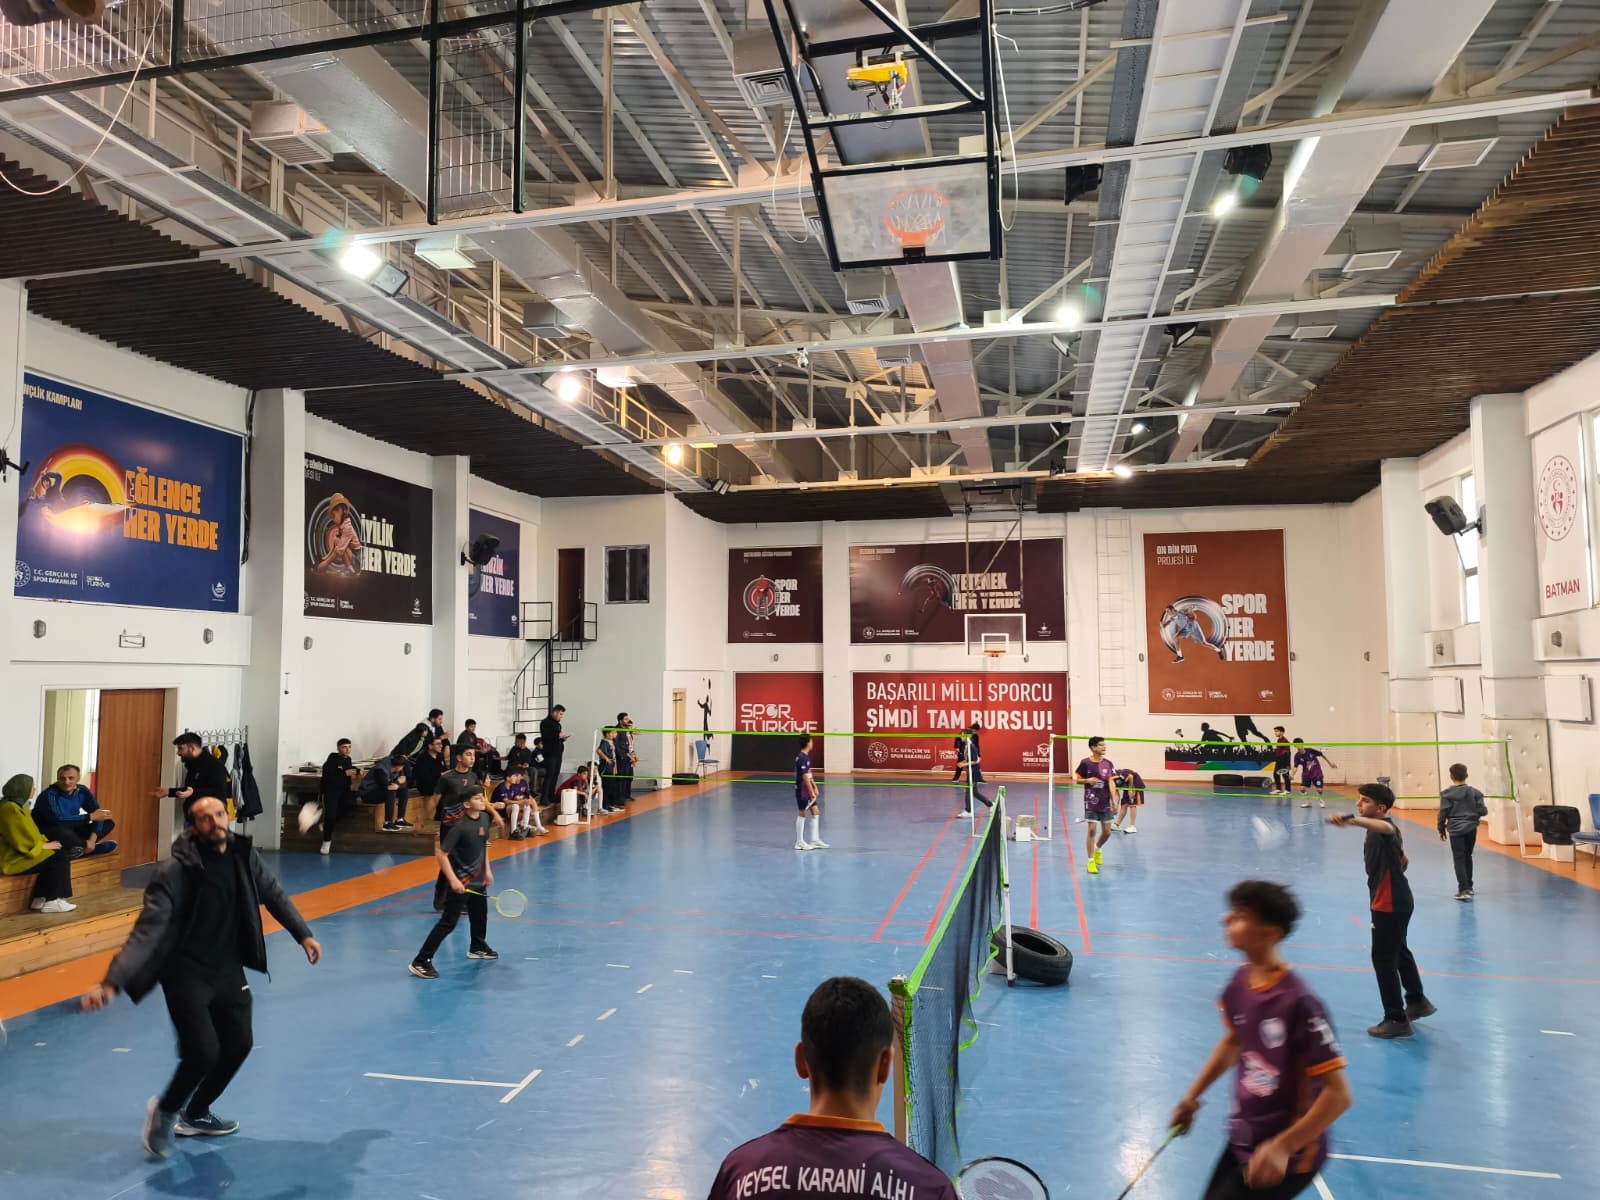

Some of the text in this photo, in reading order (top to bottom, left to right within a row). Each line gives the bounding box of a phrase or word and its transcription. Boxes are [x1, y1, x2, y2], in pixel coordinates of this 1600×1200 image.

[46, 390, 83, 411] KAMPLARI
[126, 466, 201, 514] EĞLENCE
[124, 506, 218, 551] HER YERDE
[361, 513, 394, 548] İYİLİK
[361, 546, 416, 577] HER YERDE
[44, 570, 69, 579] GENÇLİK
[775, 579, 798, 591] SPOR
[952, 572, 1007, 590] YETENEK
[495, 576, 514, 597] YERDE
[1545, 579, 1580, 599] BATMAN
[775, 592, 791, 604] HER
[952, 591, 1021, 609] HER YERDE
[1222, 593, 1268, 615] SPOR
[775, 604, 800, 616] YERDE
[1224, 640, 1275, 662] YERDE
[867, 680, 1052, 704] BAŞARILI MİLLİ SPORCU
[741, 703, 791, 719] SPOR
[866, 704, 1053, 732] ŞİMDİ TAM BURSLU!
[741, 717, 818, 734] TÜRKİYE
[736, 1165, 791, 1200] VEYSEL
[797, 1163, 866, 1194] KARANİ
